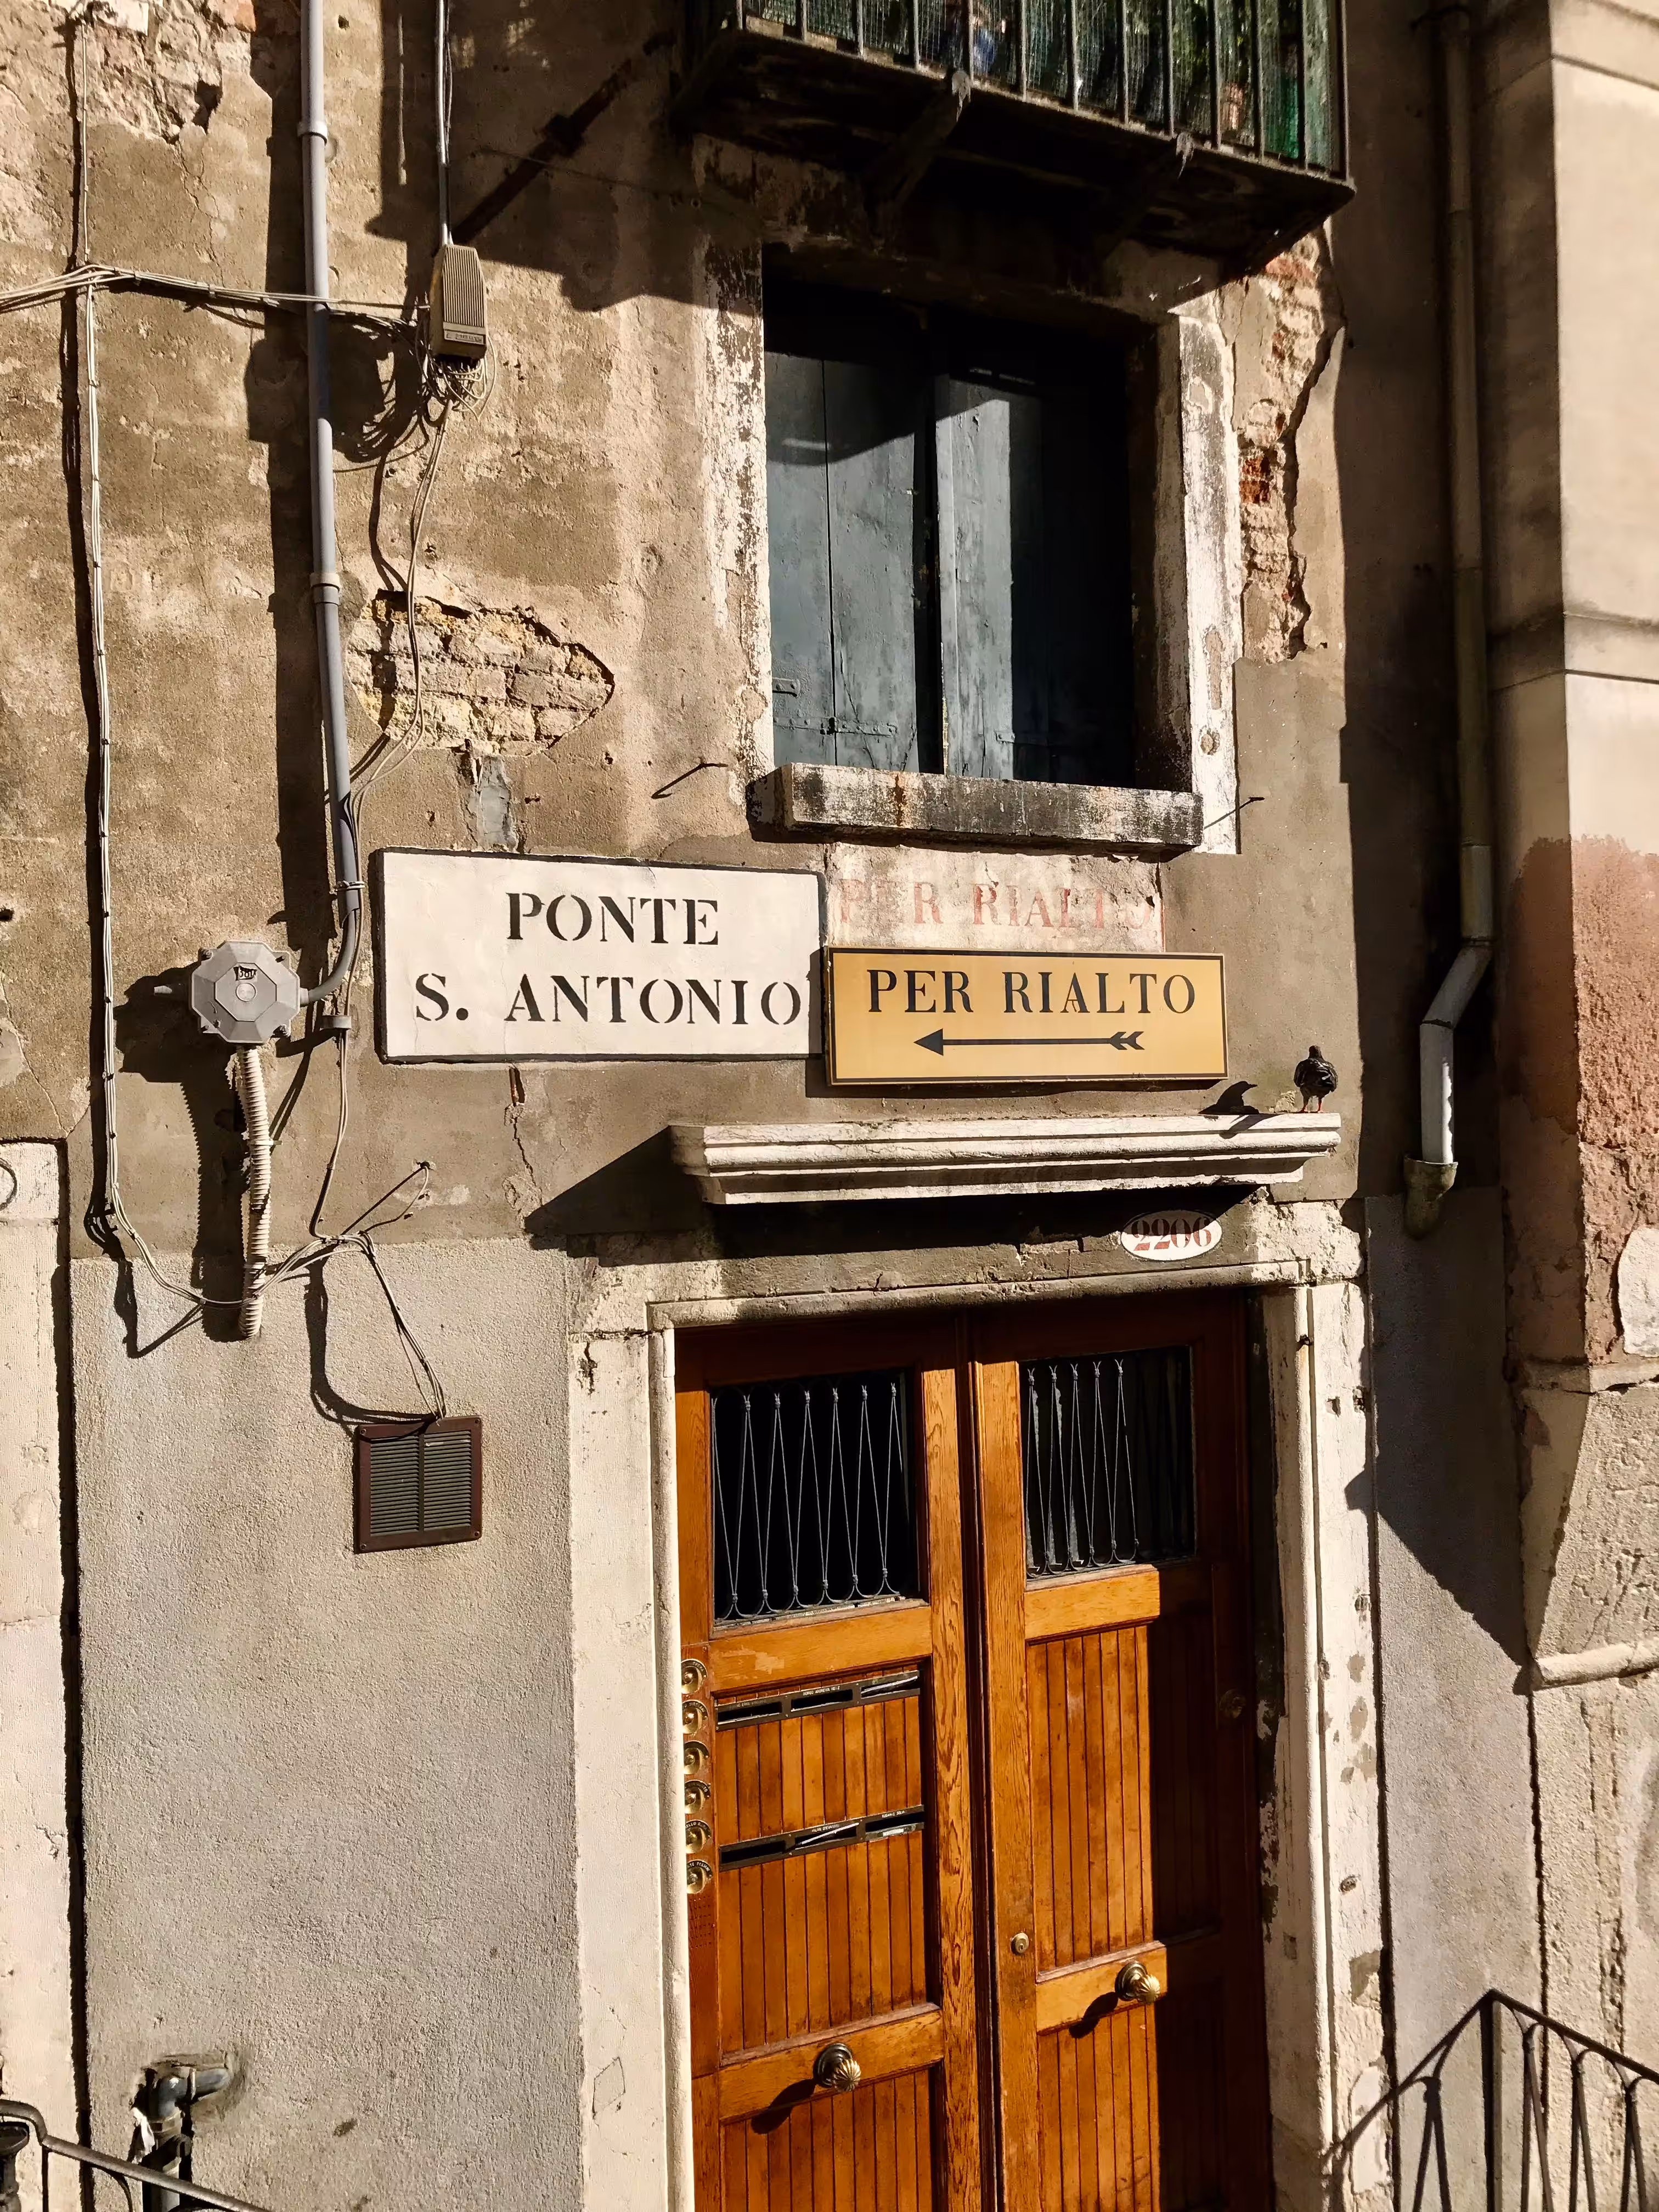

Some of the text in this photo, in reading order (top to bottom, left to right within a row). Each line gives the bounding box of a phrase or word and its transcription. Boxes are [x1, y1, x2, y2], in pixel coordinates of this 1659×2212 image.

[506, 892, 719, 945] PONTE
[415, 973, 801, 1025] S. ANTONIO
[867, 969, 1195, 1014] PER RIALTO
[1131, 1217, 1211, 1251] 2206
